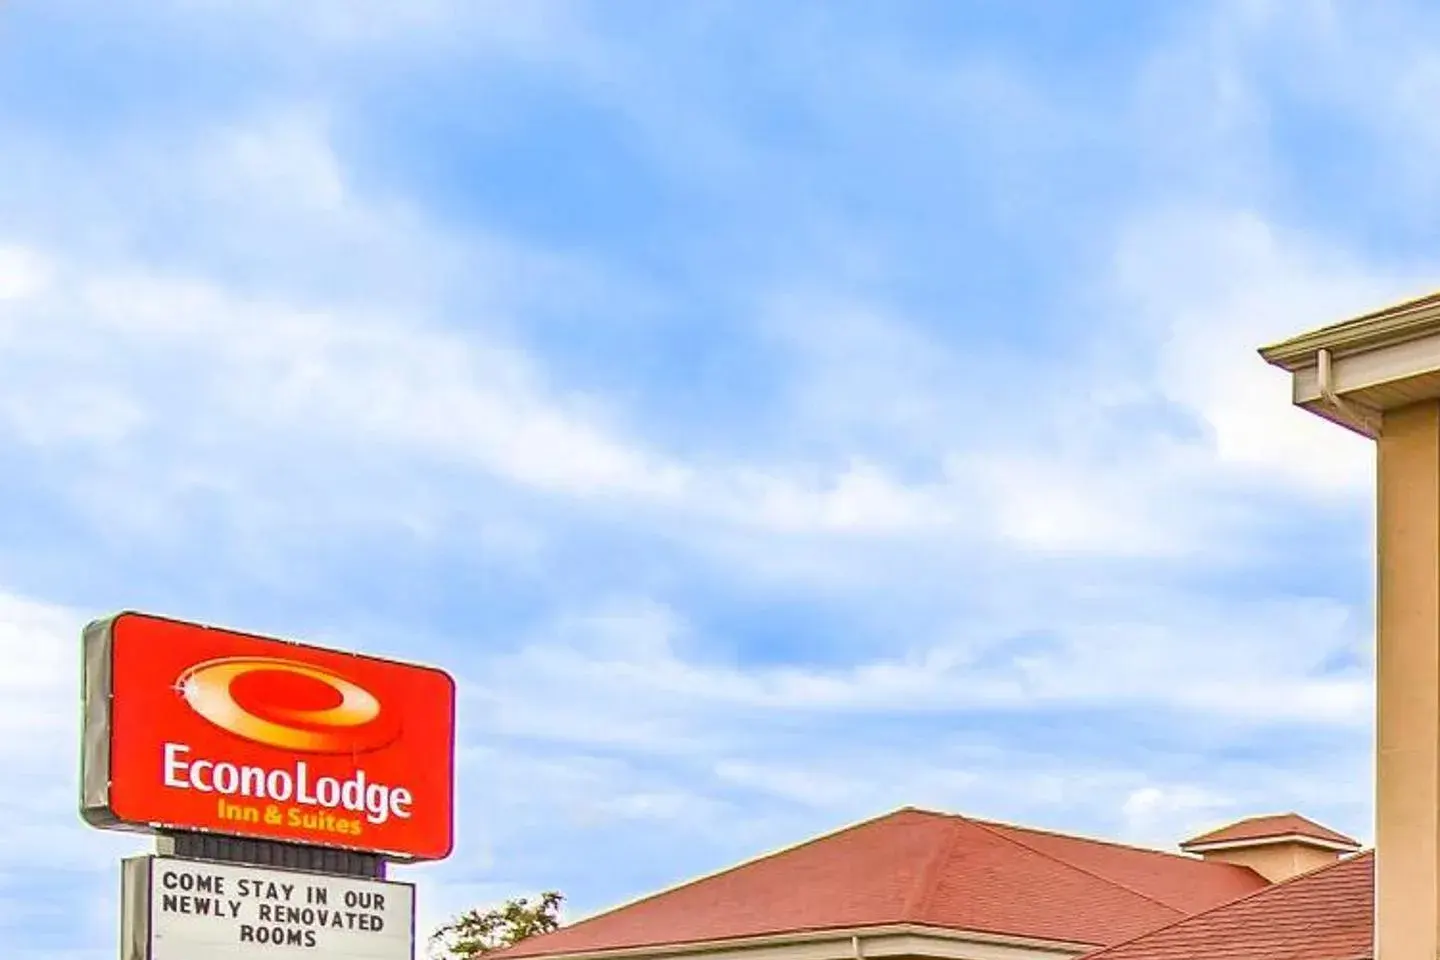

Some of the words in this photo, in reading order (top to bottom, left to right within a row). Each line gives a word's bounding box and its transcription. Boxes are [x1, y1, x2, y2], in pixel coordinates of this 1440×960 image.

[217, 799, 260, 820] Inn
[263, 806, 282, 825] &
[287, 810, 362, 836] Suites
[163, 871, 225, 895] COME
[238, 879, 294, 900] STAY
[307, 886, 327, 905] IN
[344, 890, 385, 911] OUR
[163, 894, 241, 917] NEWLY
[259, 904, 384, 932] RENOVATED
[240, 924, 316, 947] ROOMS
